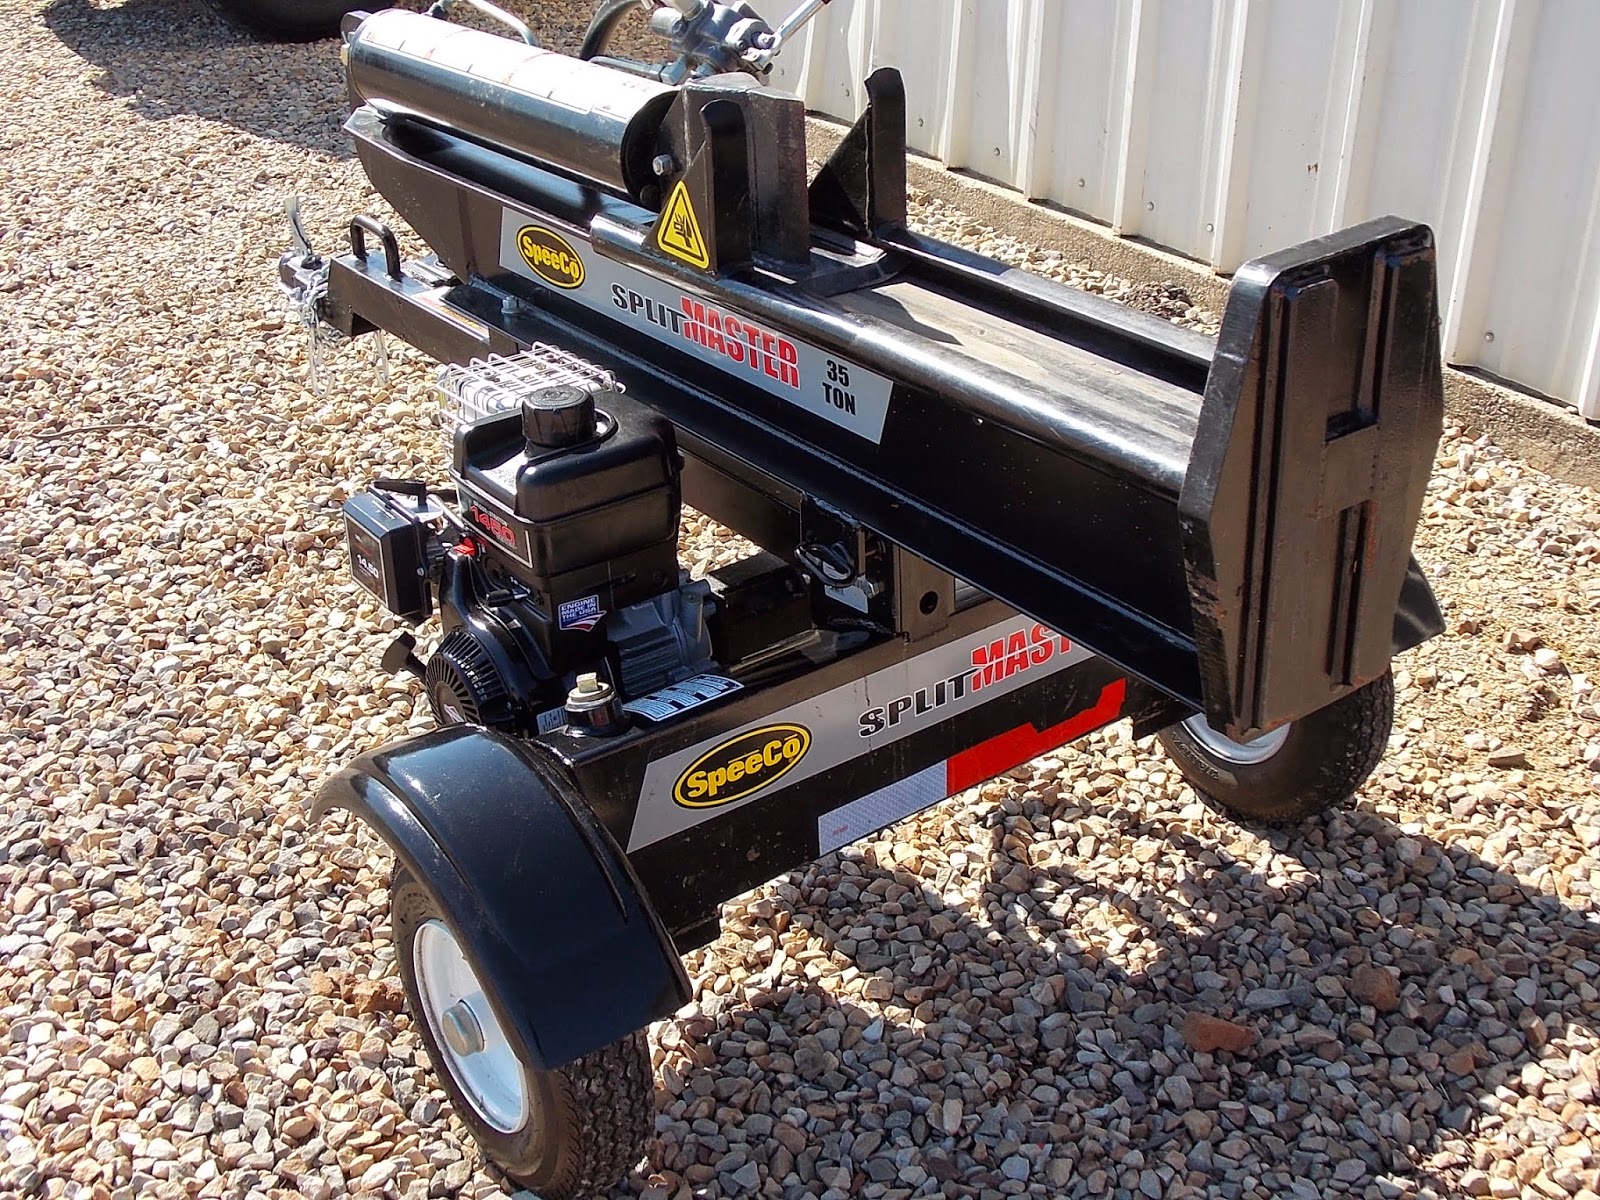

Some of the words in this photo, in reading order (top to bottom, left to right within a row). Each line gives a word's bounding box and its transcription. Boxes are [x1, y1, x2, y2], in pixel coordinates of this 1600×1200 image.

[522, 235, 580, 279] SpeeCo
[826, 358, 850, 387] 35
[822, 381, 857, 416] TON
[561, 597, 596, 611] ENGINE
[561, 605, 585, 616] MADE
[562, 612, 577, 620] THE
[579, 607, 597, 615] USA
[686, 733, 801, 798] SpeeCo
